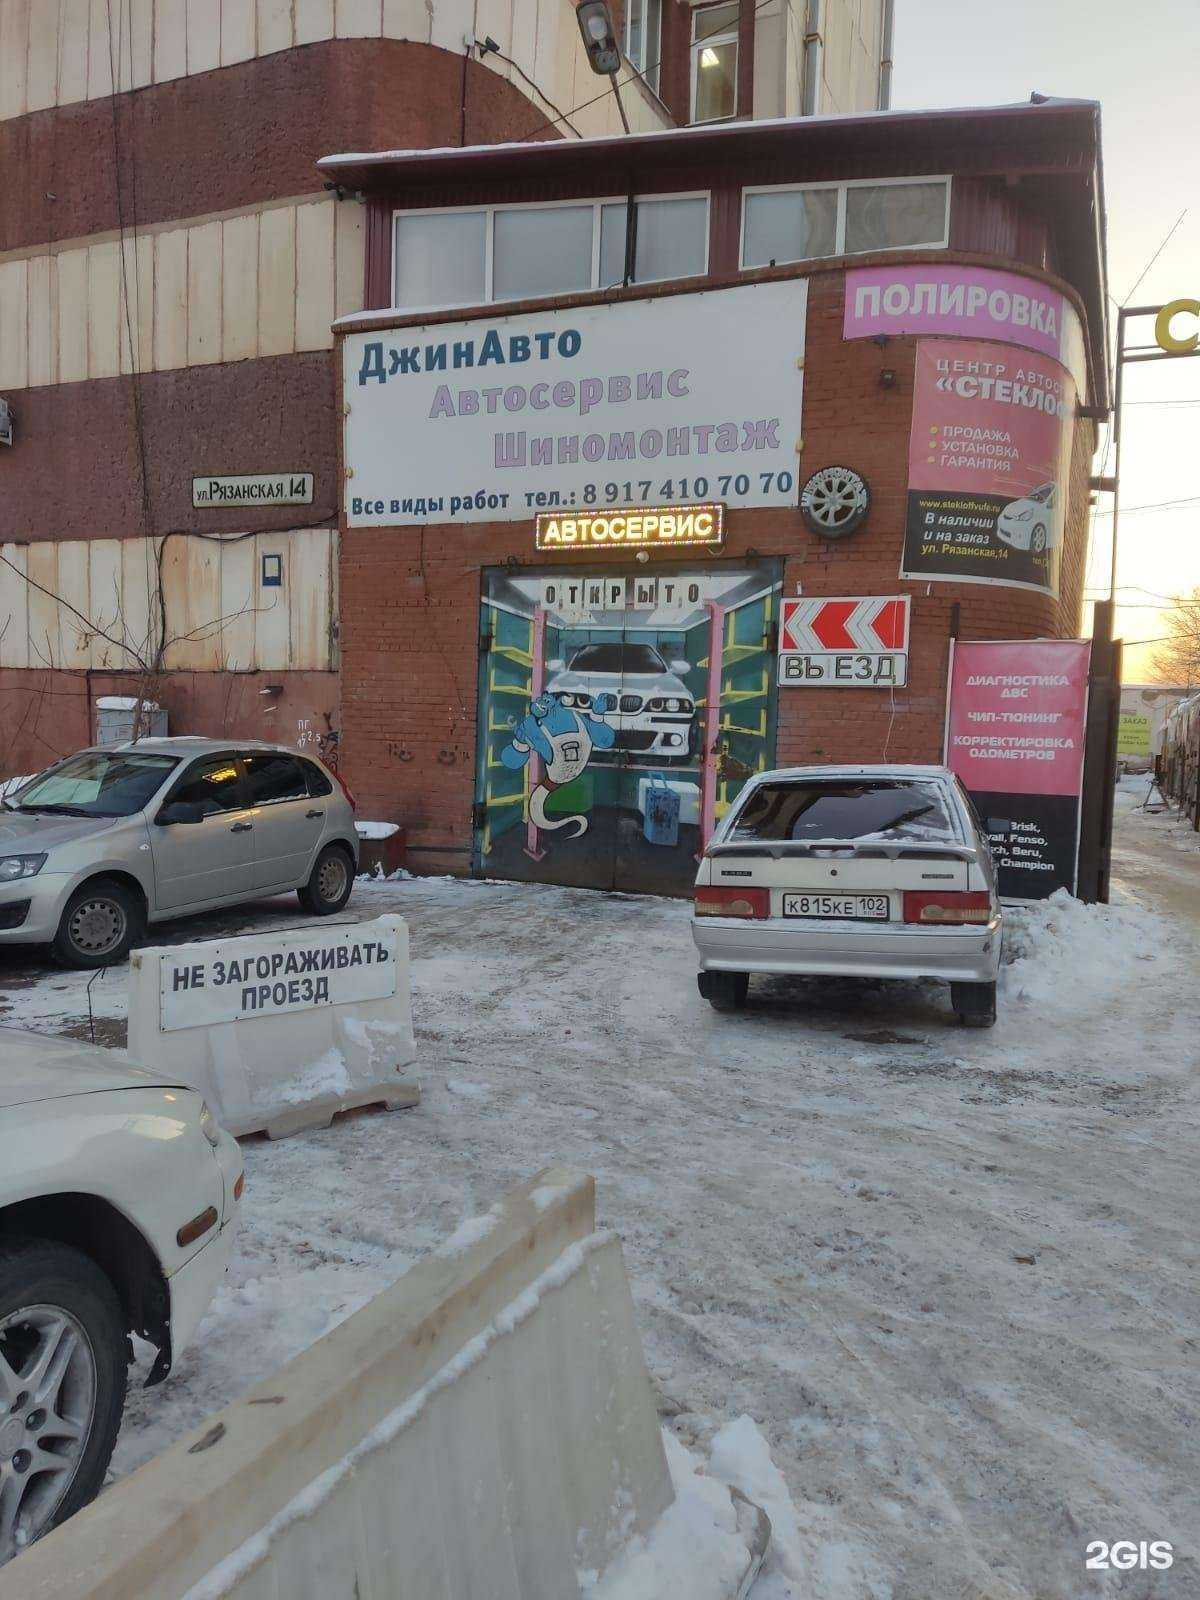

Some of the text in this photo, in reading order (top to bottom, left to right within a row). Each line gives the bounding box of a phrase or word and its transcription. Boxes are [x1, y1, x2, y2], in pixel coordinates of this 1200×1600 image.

[854, 283, 1057, 338] ПОЛИРОВКА
[359, 329, 581, 386] ДжинАвто
[936, 359, 1064, 394] ЦЕНТР АВТОС
[428, 368, 690, 418] Автосервис
[494, 416, 781, 469] Шиномонтаж
[943, 426, 1011, 442] ПРОДАЖА
[941, 441, 1019, 459] УСТАНОВКА
[940, 455, 1011, 471] ГАРАНТИЯ
[289, 477, 306, 497] 14
[352, 497, 384, 515] Все
[390, 496, 443, 515] виды
[450, 489, 509, 516] работ
[583, 484, 596, 503] 8
[605, 480, 652, 502] 917
[659, 477, 709, 499] 410
[718, 474, 750, 496] 70
[760, 471, 793, 493] 70
[544, 513, 713, 542] АВТОСЕРВИС
[925, 512, 994, 528] В наличии
[924, 530, 990, 544] и на заказ
[921, 545, 939, 556] ул.
[546, 582, 699, 605] ОТКРЫТО
[966, 675, 1070, 686] ДИАГНОСТИКА
[1001, 688, 1029, 698] ДВС
[967, 711, 1062, 723] ЧИП-ТЮНИНГ
[953, 736, 1074, 748] КОРРЕКТИРОВКА
[969, 748, 1055, 760] ОДОМЕТРОВ
[1001, 859, 1054, 870] Champion
[859, 898, 884, 910] 102
[172, 942, 389, 991] НЕ ЗАГОРАЖИВАТЬ
[241, 976, 329, 1010] ПРОЕЗД
